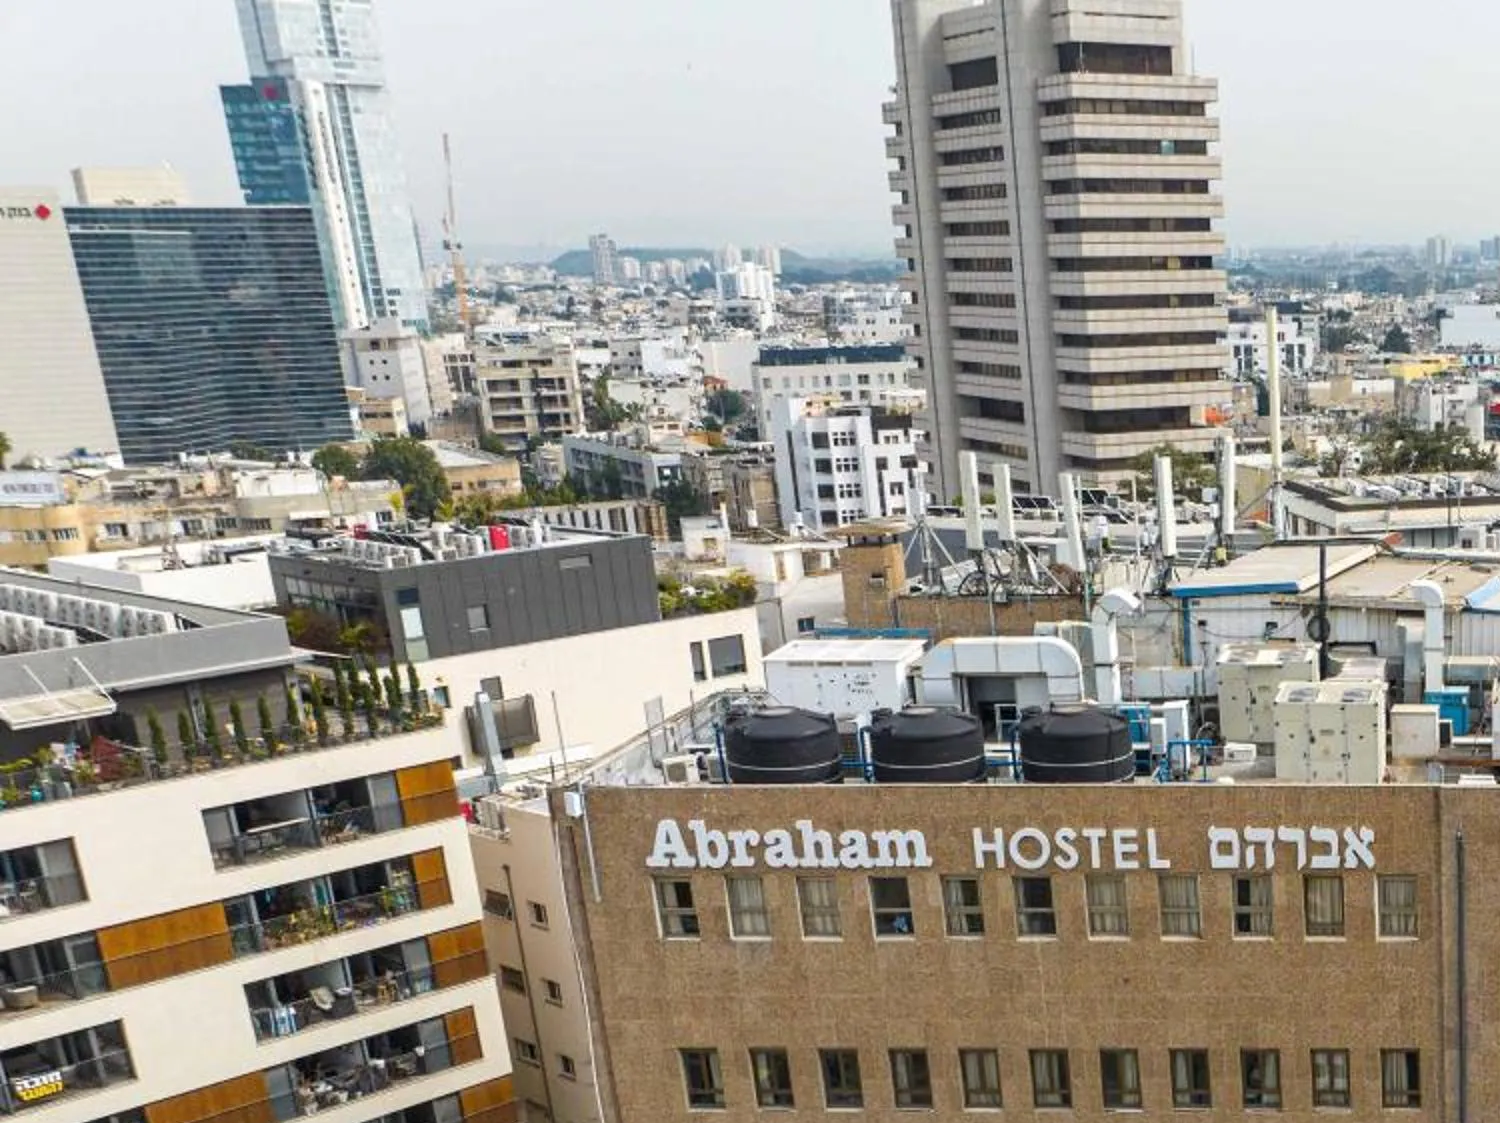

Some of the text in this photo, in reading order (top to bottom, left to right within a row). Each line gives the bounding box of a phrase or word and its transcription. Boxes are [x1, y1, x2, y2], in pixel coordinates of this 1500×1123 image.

[646, 819, 1171, 870] Abraham HOSTEL
[1207, 825, 1376, 871] אברהם
